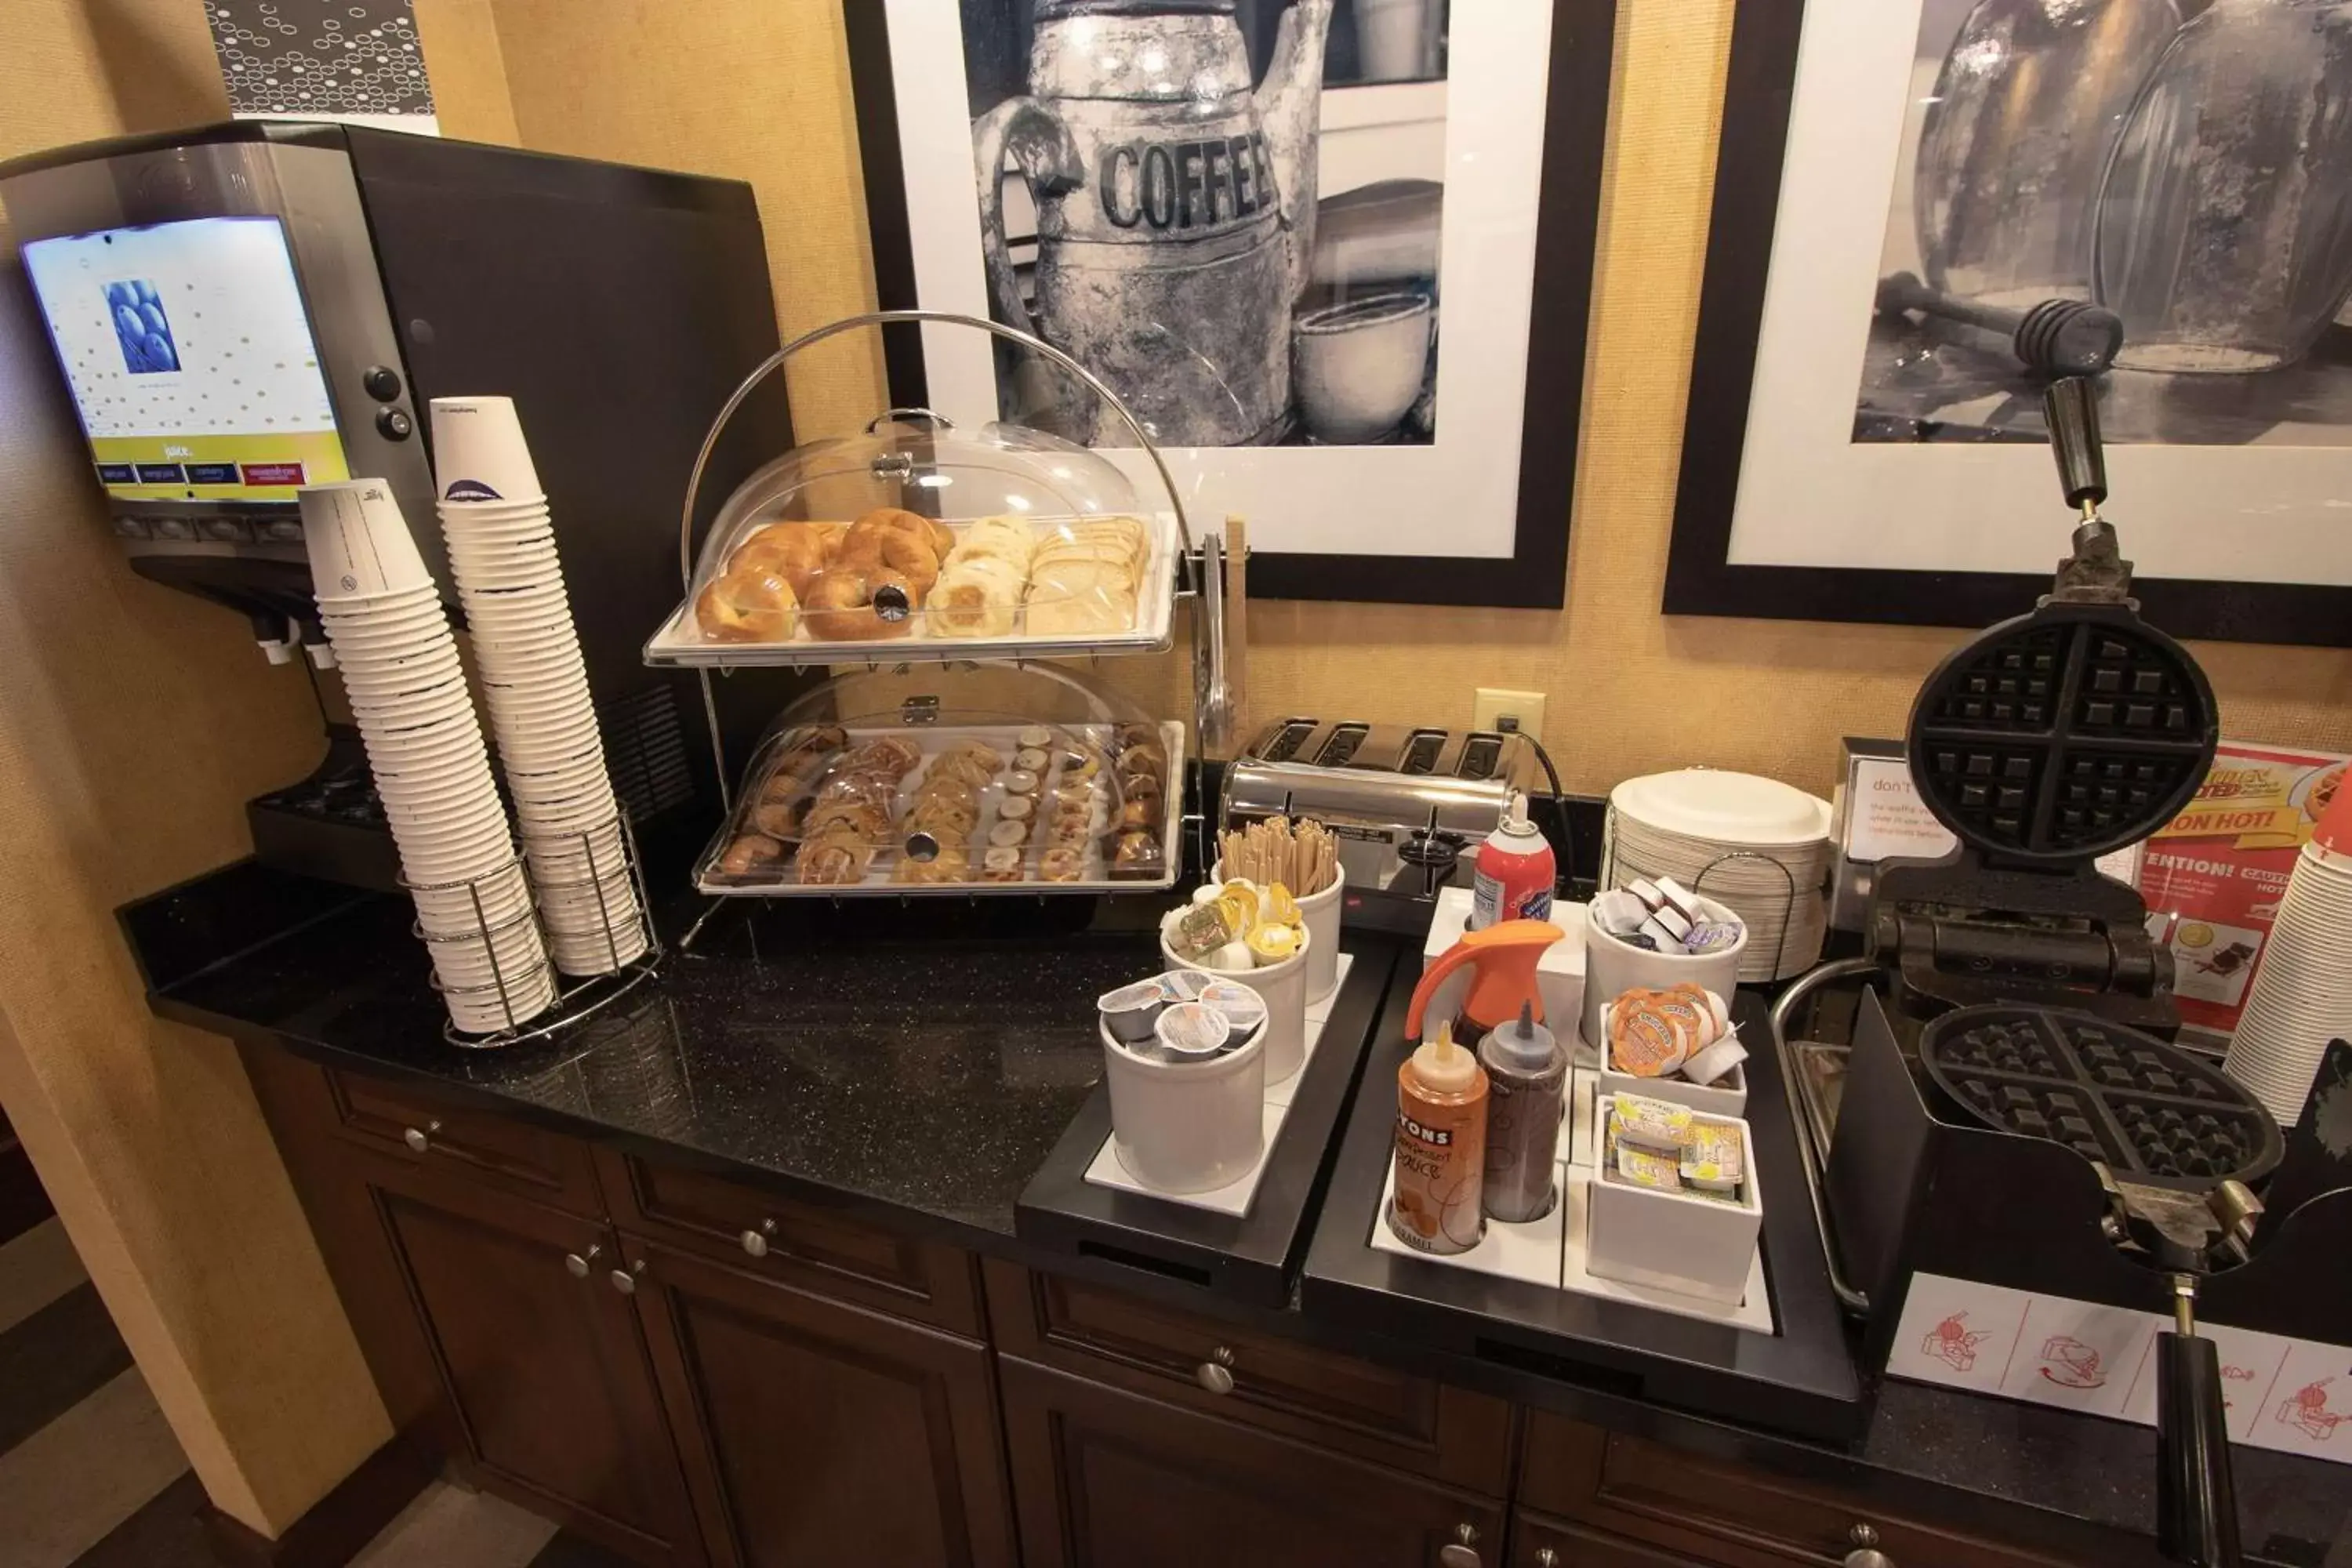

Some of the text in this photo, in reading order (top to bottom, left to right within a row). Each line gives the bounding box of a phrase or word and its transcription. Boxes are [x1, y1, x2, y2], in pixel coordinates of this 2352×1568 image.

[1099, 132, 1273, 229] COFFEE
[2216, 811, 2277, 829] HOT!
[2144, 852, 2235, 877] ENTION!
